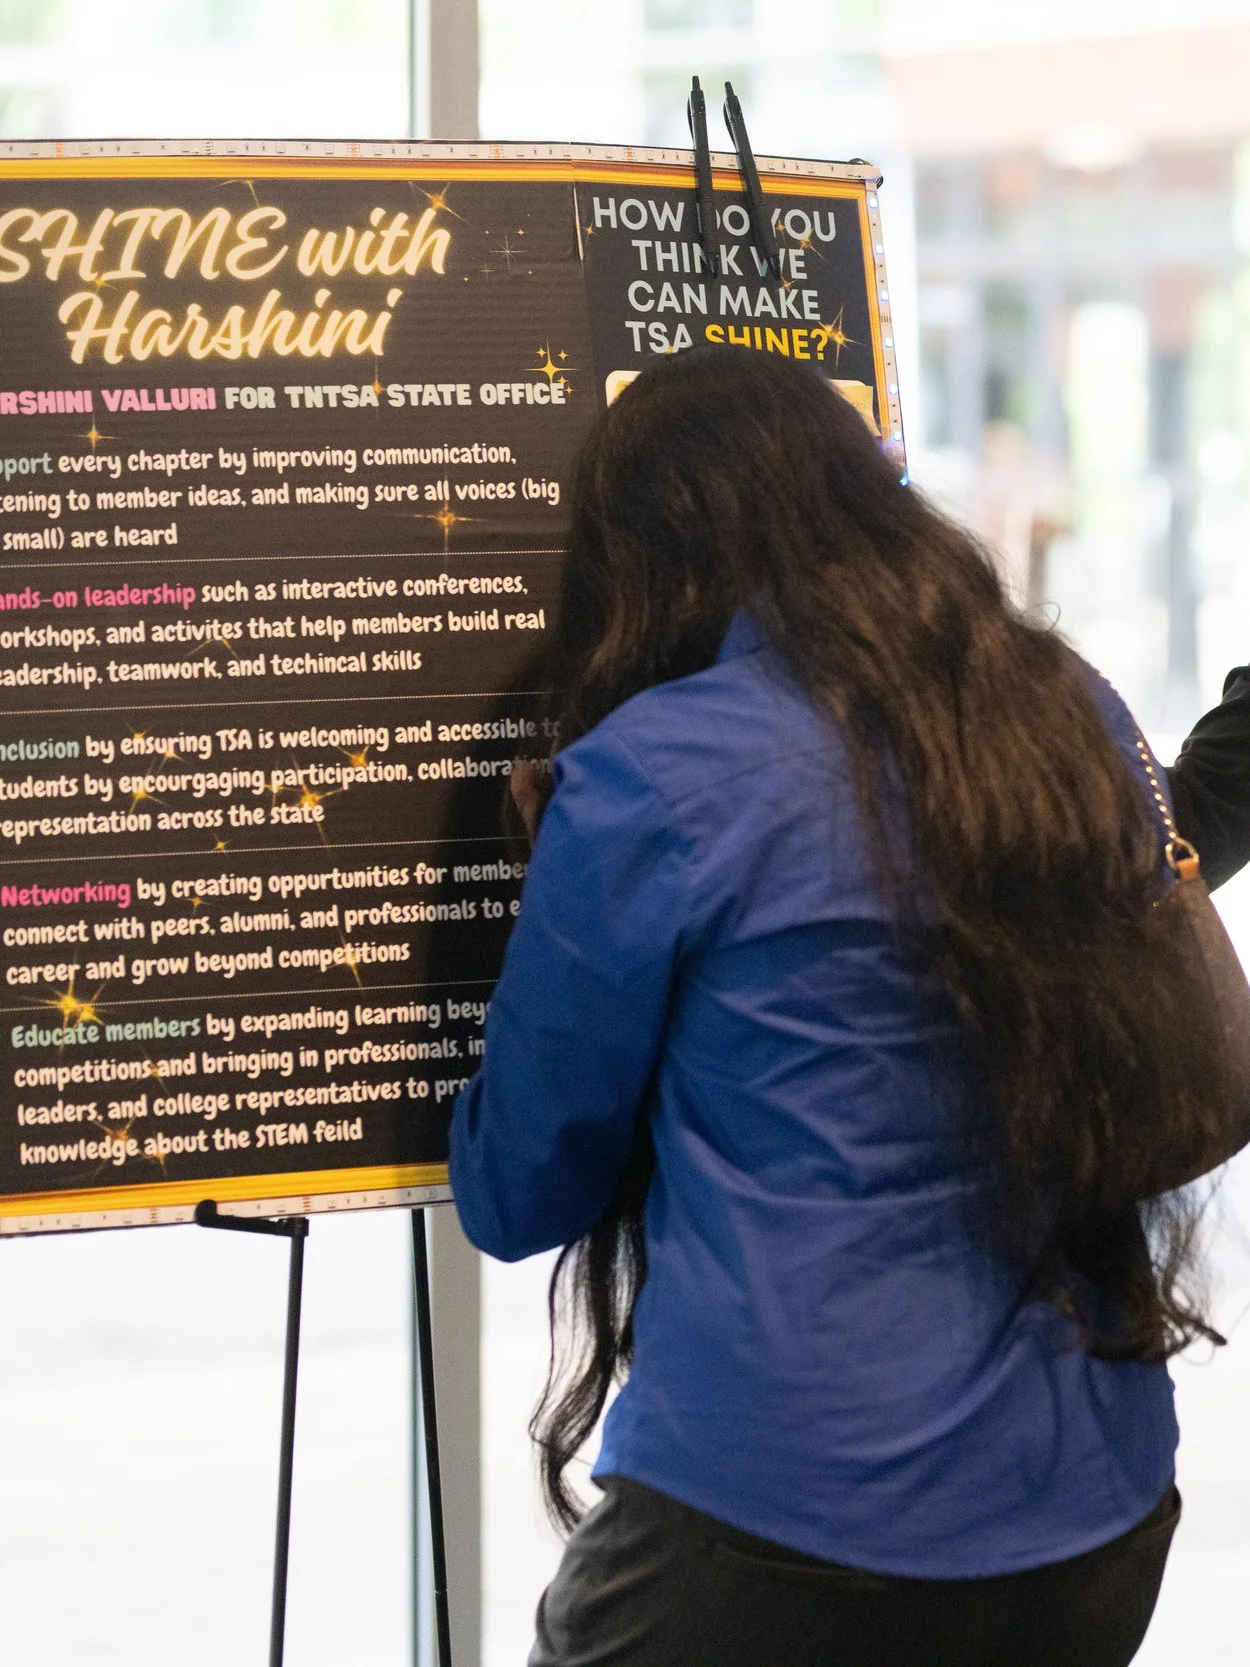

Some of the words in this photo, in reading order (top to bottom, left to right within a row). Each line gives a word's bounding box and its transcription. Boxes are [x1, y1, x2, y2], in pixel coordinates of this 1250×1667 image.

[593, 197, 684, 232] HOW
[697, 203, 750, 236] O
[0, 207, 288, 282] SHINE
[297, 207, 451, 276] with
[628, 281, 707, 314] CAN
[720, 285, 820, 321] MAKE
[59, 288, 402, 364] Harshini
[625, 321, 692, 354] TSA
[705, 324, 828, 360] SHINE?
[101, 388, 216, 411] VALLURI
[225, 387, 276, 409] FOR
[284, 385, 380, 408] TNTSA
[387, 384, 472, 407] STATE
[480, 383, 566, 406] OFFICE
[58, 455, 121, 478] every
[128, 449, 213, 476] chapter
[219, 448, 246, 475] by
[253, 446, 356, 474] improving
[363, 443, 516, 465] communication,
[66, 490, 90, 510] to
[97, 487, 182, 509] member
[188, 485, 246, 506] ideas,
[252, 482, 289, 505] and
[296, 483, 369, 509] making
[375, 485, 419, 501] sure
[424, 480, 450, 501] all
[455, 480, 515, 500] voices
[522, 478, 559, 505] (big
[3, 527, 64, 550] small)
[71, 530, 108, 548] are
[115, 523, 177, 546] heard
[85, 583, 195, 610] leadership
[202, 581, 248, 602] such
[255, 583, 276, 600] as
[283, 577, 397, 599] interactive
[403, 574, 527, 596] conferences,
[106, 621, 145, 644] and
[152, 619, 242, 642] activites
[247, 617, 296, 638] that
[301, 616, 346, 642] help
[352, 613, 442, 634] members
[448, 609, 499, 631] build
[505, 609, 545, 629] real
[0, 663, 103, 689] adership,
[107, 657, 222, 682] teamwork,
[227, 654, 265, 676] and
[270, 652, 366, 675] techincal
[372, 650, 421, 671] skills
[86, 736, 114, 763] by
[121, 732, 212, 759] ensuring
[216, 729, 252, 751] TSA
[259, 729, 274, 748] is
[280, 725, 389, 751] welcoming
[395, 721, 432, 743] and
[438, 718, 537, 741] accessible
[84, 774, 113, 802] by
[119, 767, 265, 798] encourgaging
[271, 761, 413, 789] participation,
[0, 811, 151, 844] epresentation
[157, 809, 223, 829] across
[227, 805, 265, 826] the
[271, 802, 325, 825] state
[1, 881, 131, 908] Networking
[137, 878, 166, 906] by
[172, 874, 262, 901] creating
[268, 866, 409, 898] oppurtunities
[413, 863, 447, 884] for
[3, 920, 89, 946] connect
[94, 917, 145, 940] with
[151, 916, 215, 944] peers,
[220, 912, 295, 933] alumni,
[300, 905, 338, 928] and
[345, 901, 475, 933] professionals
[481, 898, 503, 918] to
[6, 964, 80, 985] career
[86, 955, 125, 979] and
[132, 957, 188, 984] grow
[195, 946, 273, 978] beyond
[279, 942, 409, 972] competitions
[12, 1024, 100, 1048] Educate
[106, 1017, 200, 1041] members
[206, 1014, 235, 1041] by
[241, 1006, 349, 1038] expanding
[355, 1005, 439, 1028] learning
[14, 1060, 152, 1091] competitions
[157, 1053, 196, 1077] and
[202, 1049, 293, 1078] bringing
[300, 1047, 318, 1067] in
[325, 1039, 463, 1071] professionals,
[18, 1100, 103, 1126] leaders,
[108, 1094, 147, 1119] and
[153, 1093, 230, 1120] college
[236, 1081, 401, 1115] representatives
[406, 1078, 428, 1098] to
[21, 1136, 140, 1165] knowledge
[144, 1131, 209, 1155] about
[212, 1128, 250, 1150] the
[256, 1123, 308, 1147] STEM
[313, 1117, 362, 1142] feild
